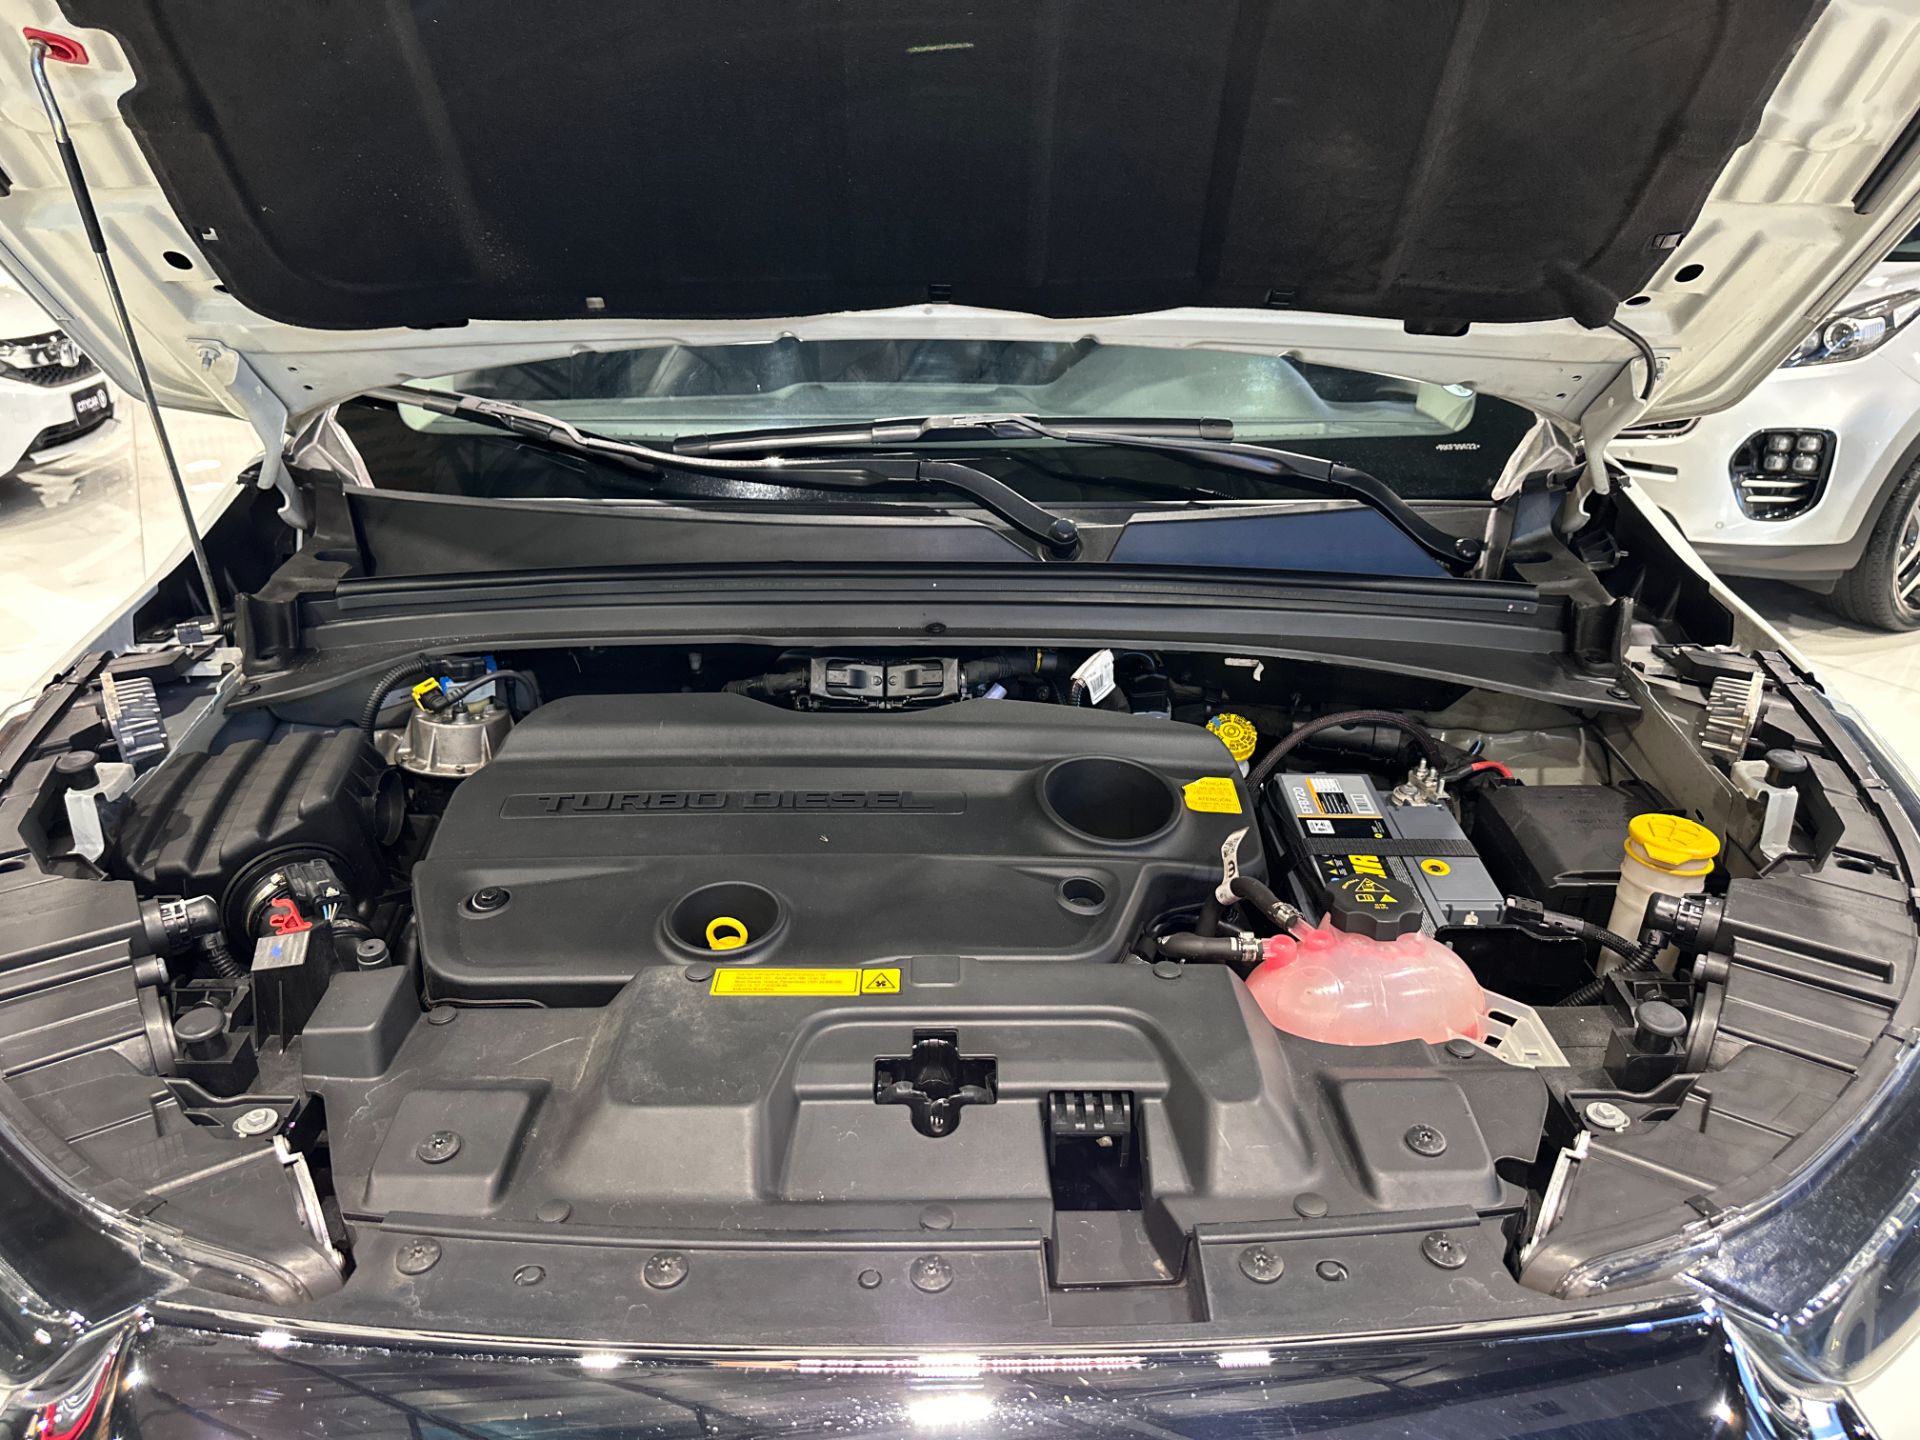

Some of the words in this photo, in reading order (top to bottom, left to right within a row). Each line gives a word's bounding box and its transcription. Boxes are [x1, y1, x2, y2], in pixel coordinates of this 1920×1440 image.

[539, 791, 729, 812] TURBO
[742, 790, 934, 810] DIESEL
[1292, 787, 1313, 814] EFB720
